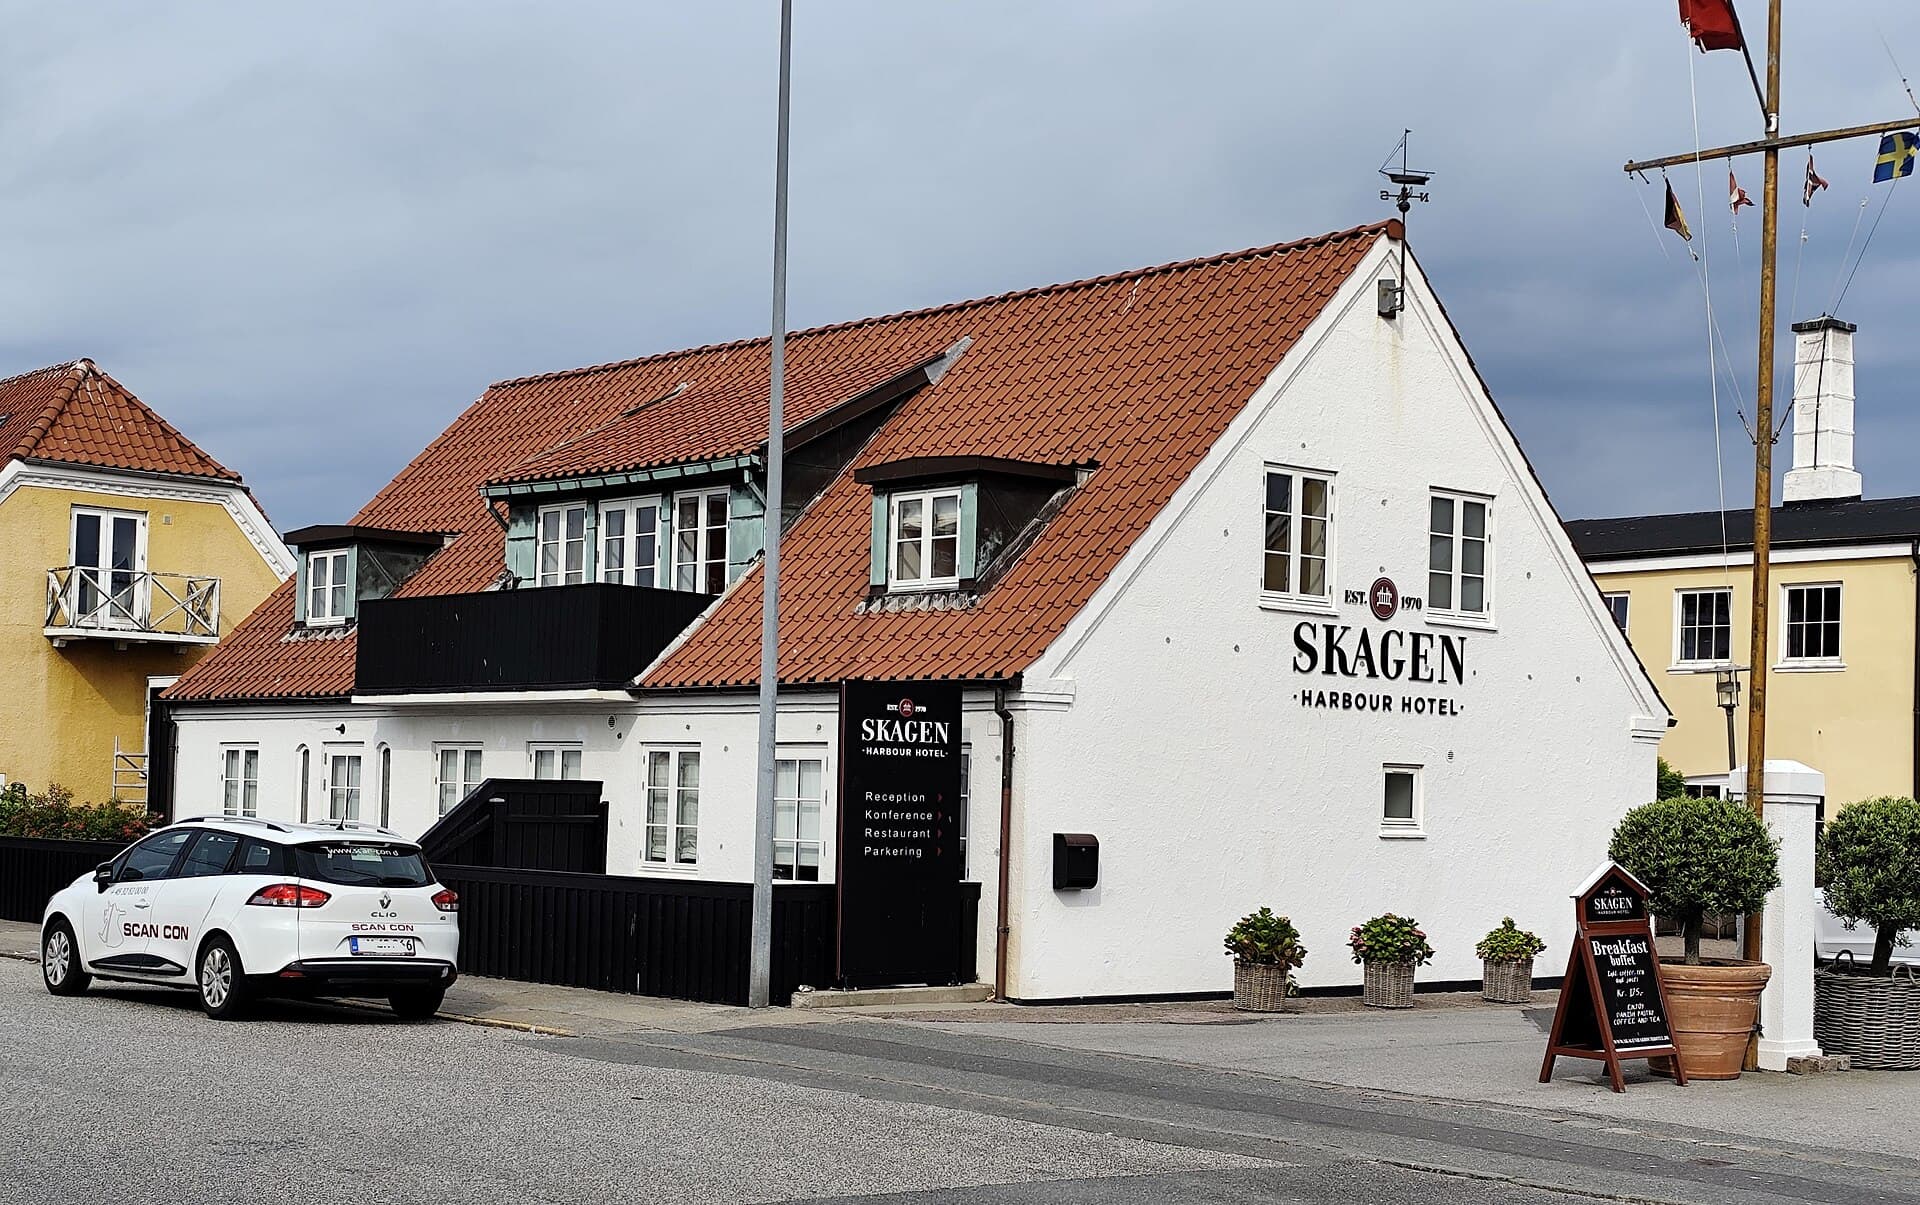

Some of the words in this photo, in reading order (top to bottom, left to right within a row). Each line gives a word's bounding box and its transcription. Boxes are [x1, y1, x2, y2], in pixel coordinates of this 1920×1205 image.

[1345, 589, 1368, 605] EST.
[1401, 596, 1422, 610] 1970
[1293, 621, 1467, 685] SKAGEN
[1301, 689, 1393, 712] HARBOUR
[1401, 696, 1459, 716] HOTEL
[861, 718, 950, 744] SKAGEN
[866, 746, 912, 757] HARBOUR
[915, 748, 945, 758] HOTEL
[865, 791, 925, 804] Reception
[865, 809, 933, 820] Konference
[864, 827, 930, 839] Restaurant
[864, 846, 922, 858] Parkering
[1594, 897, 1632, 910] SKAGEN
[123, 922, 159, 938] SCAN
[163, 925, 189, 940] CON
[390, 924, 413, 932] CON
[1591, 939, 1648, 956] Breakfast
[1609, 954, 1636, 966] buffet
[1613, 1017, 1636, 1025] COFFEE
[1649, 1015, 1661, 1023] TEA
